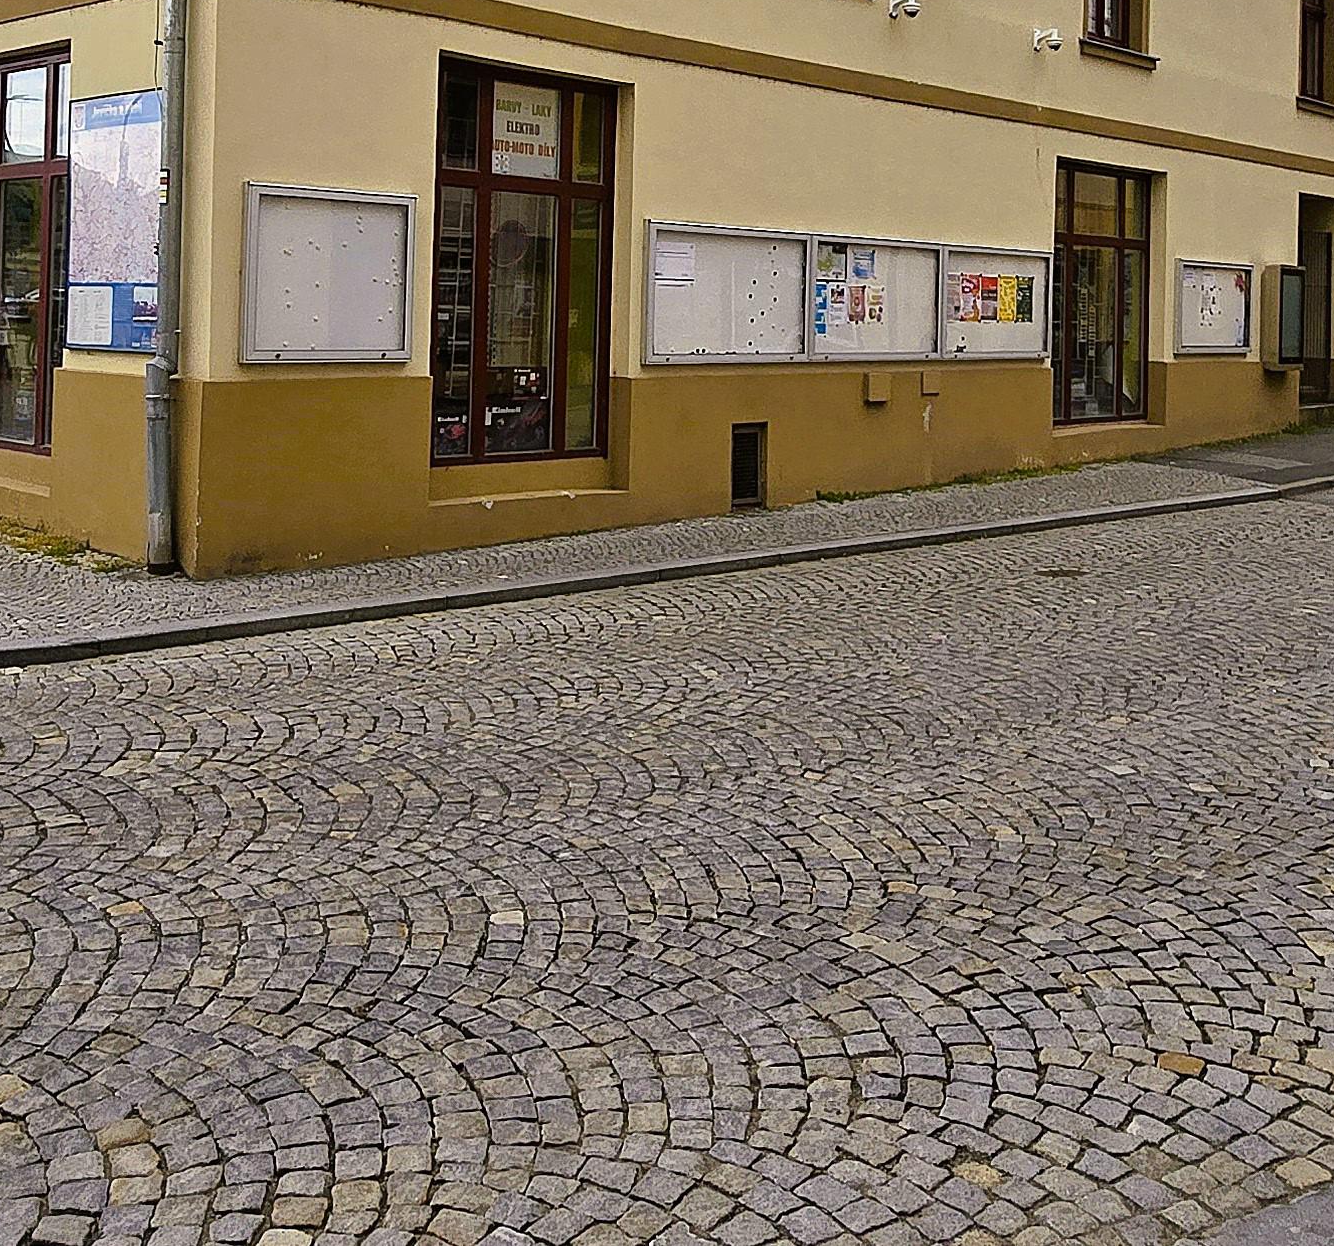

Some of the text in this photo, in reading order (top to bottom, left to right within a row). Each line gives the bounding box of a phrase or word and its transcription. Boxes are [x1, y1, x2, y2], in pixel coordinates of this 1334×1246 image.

[496, 99, 522, 113] BARVY
[531, 104, 552, 118] LAKY
[507, 121, 540, 136] ELEKTRO
[492, 139, 535, 155] UTO-MOTO
